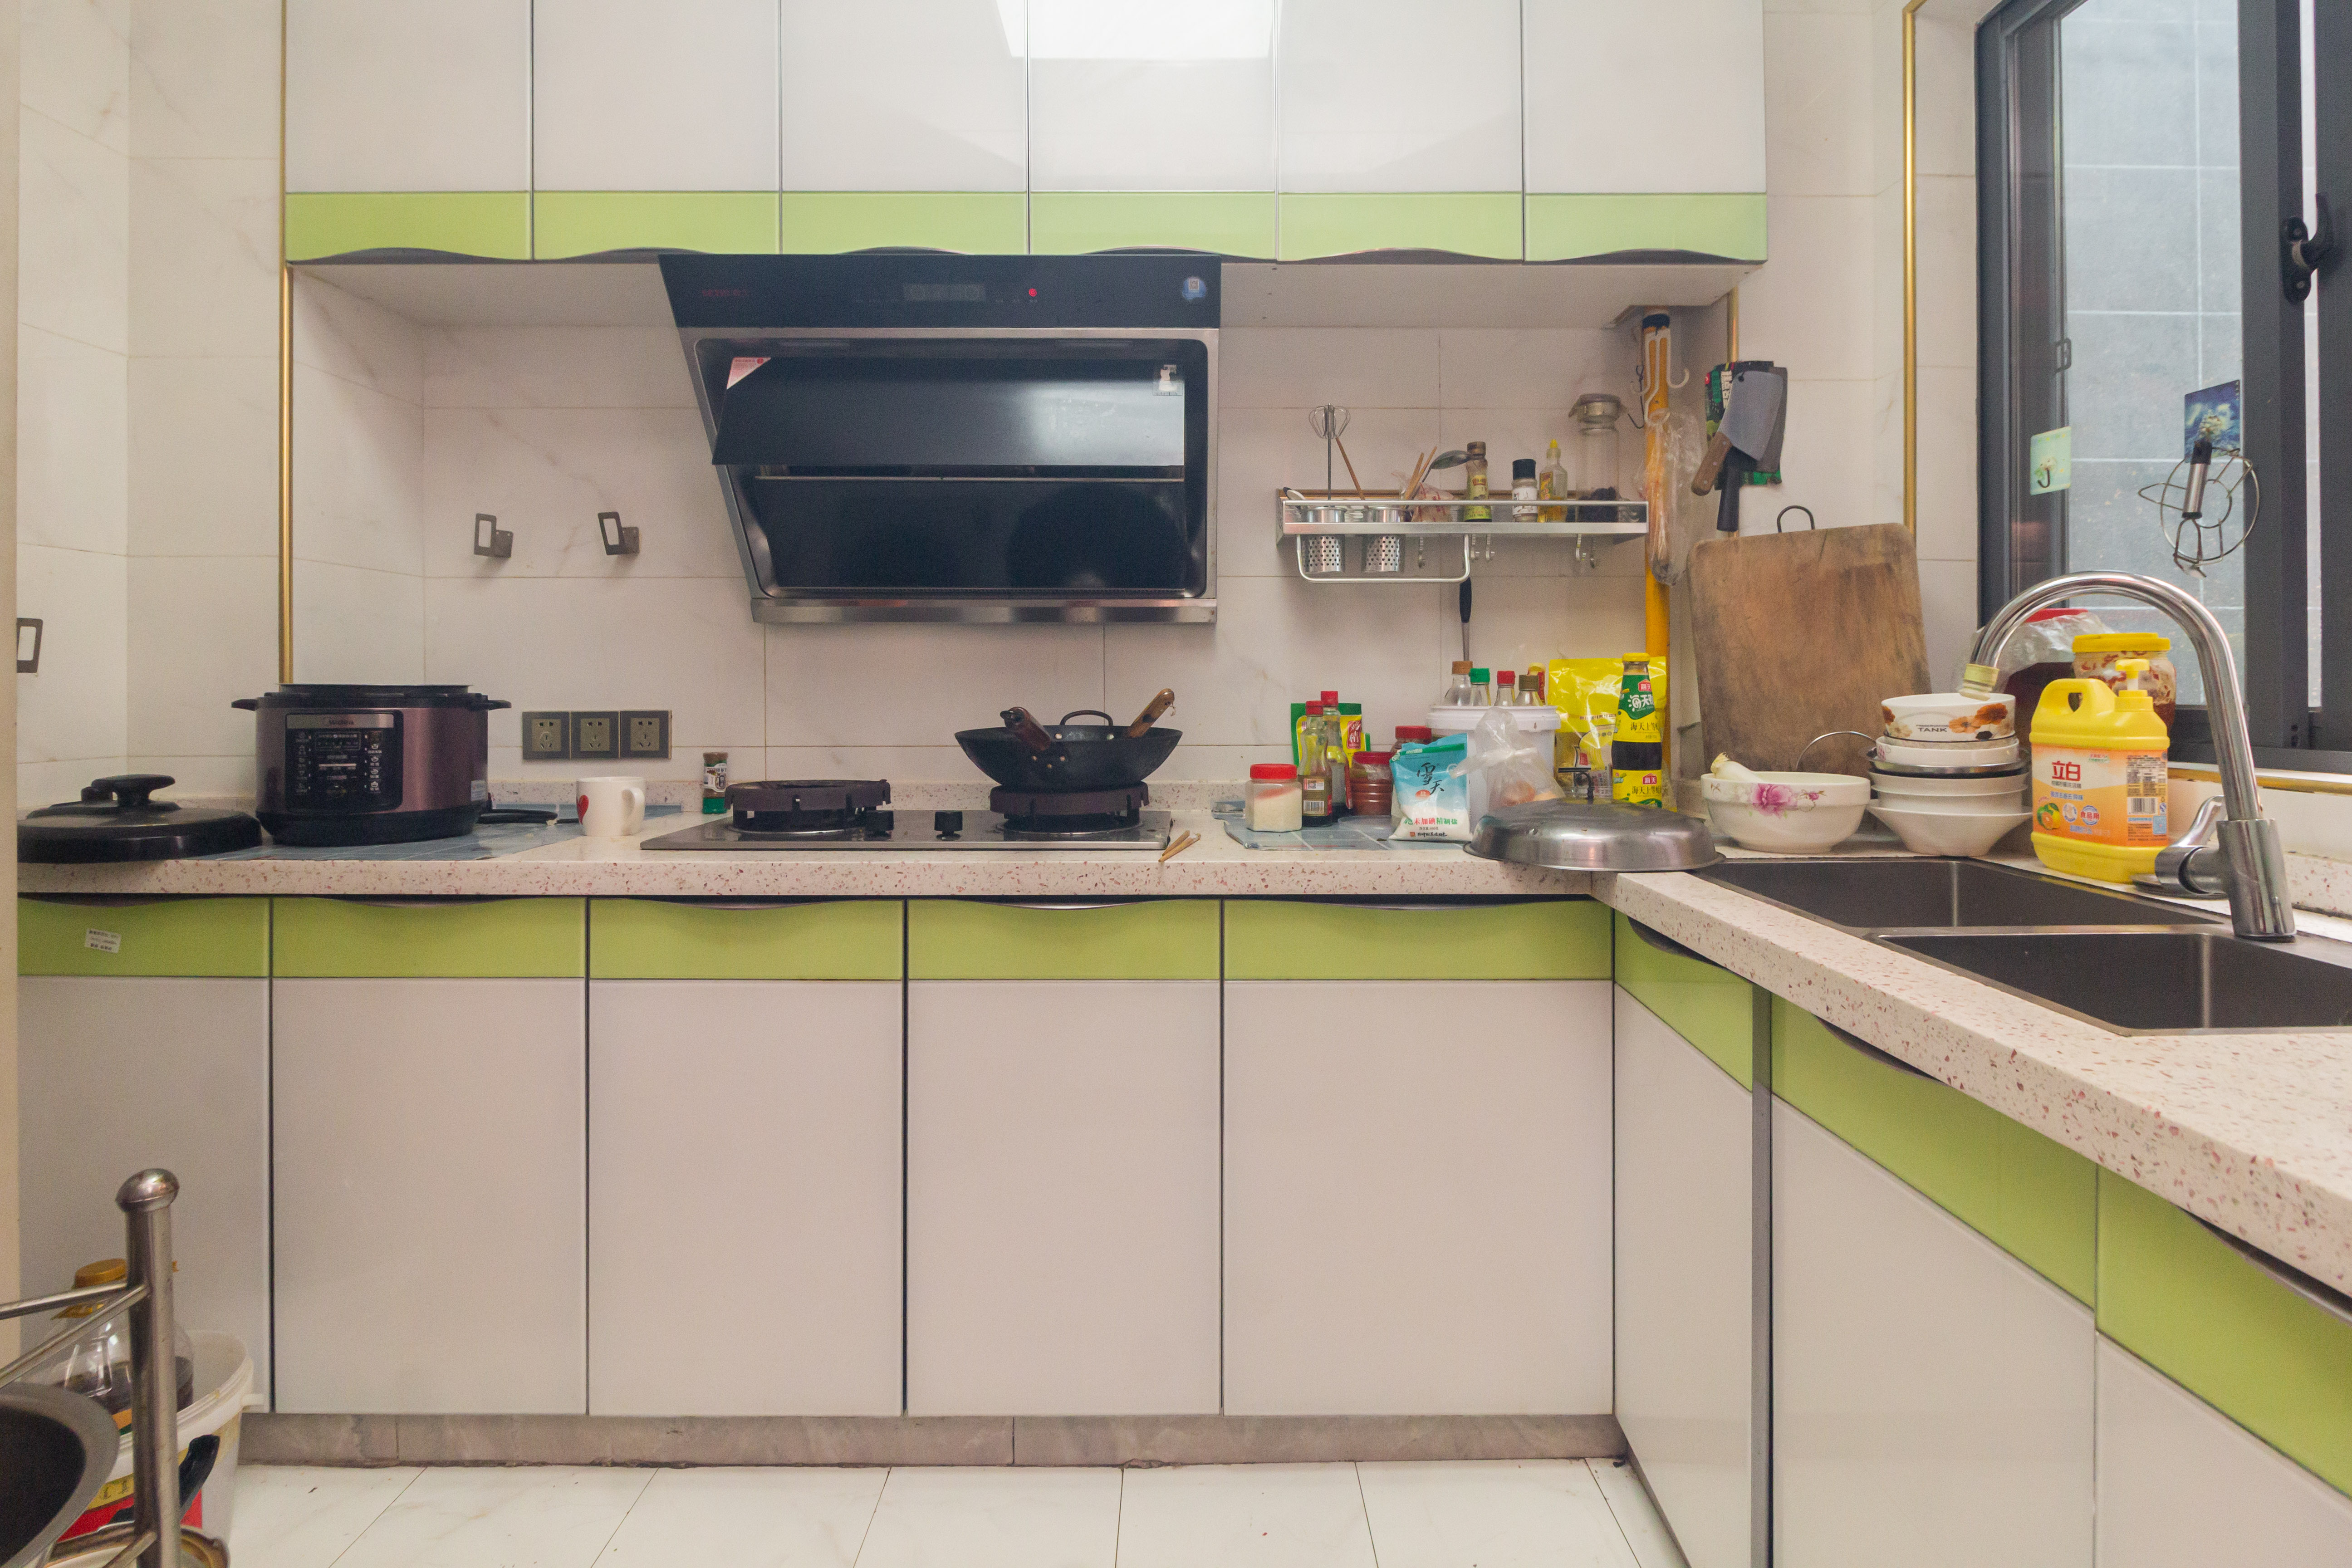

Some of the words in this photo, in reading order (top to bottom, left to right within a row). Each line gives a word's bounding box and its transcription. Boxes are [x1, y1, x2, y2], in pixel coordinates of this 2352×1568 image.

[1416, 762, 1445, 795] 雪天
[2052, 761, 2081, 781] 立白
[2080, 811, 2100, 820] 食品用
